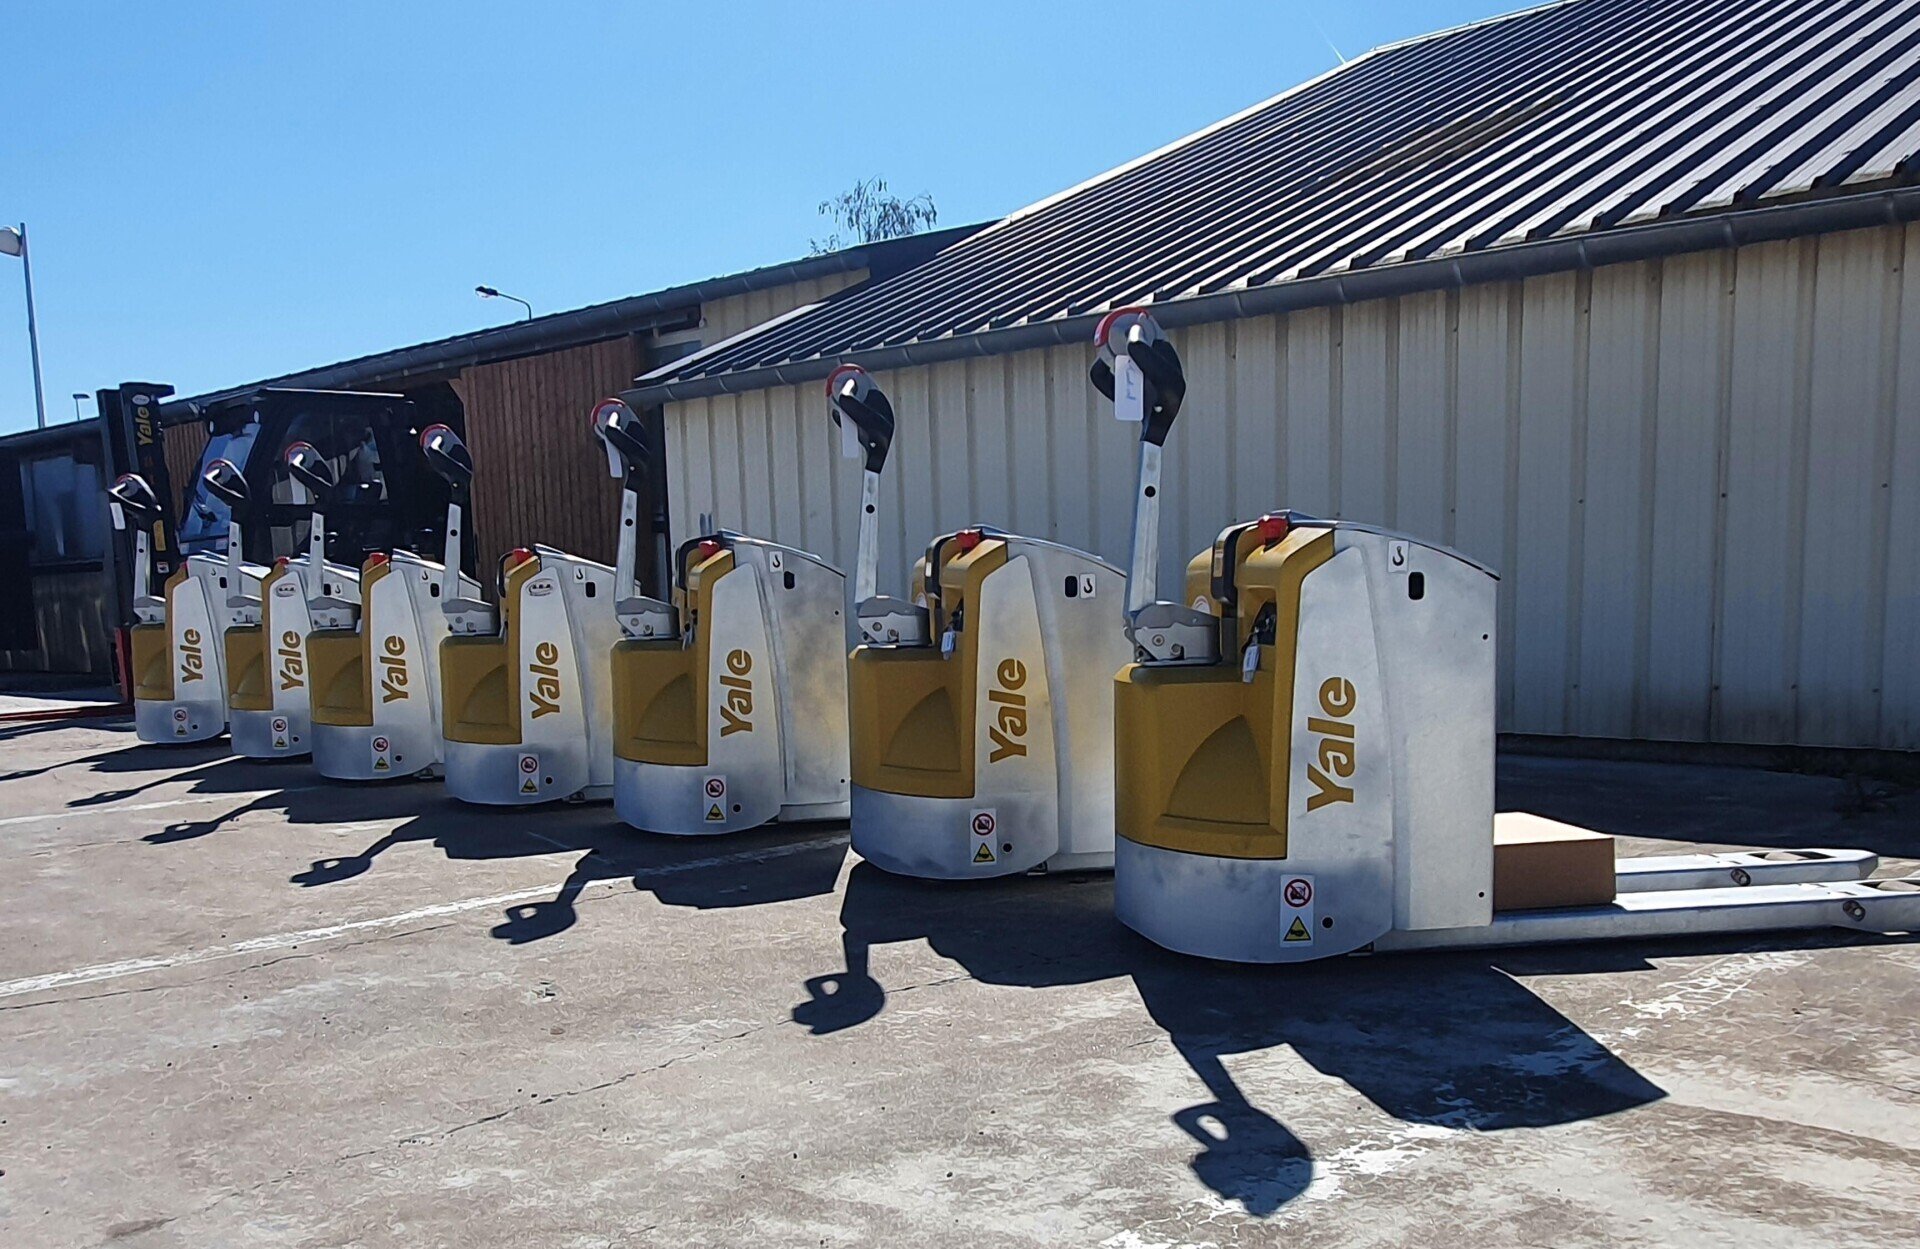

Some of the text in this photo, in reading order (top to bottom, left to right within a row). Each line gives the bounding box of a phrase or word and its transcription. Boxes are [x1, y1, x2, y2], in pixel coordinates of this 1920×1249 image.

[135, 406, 153, 446] Yale
[179, 628, 204, 684] Yale
[281, 630, 304, 691] Yale
[379, 635, 409, 704] Yale
[529, 641, 560, 720] Yale
[720, 649, 753, 738] Yale
[989, 658, 1027, 763] Yale
[1307, 676, 1356, 812] Yale
